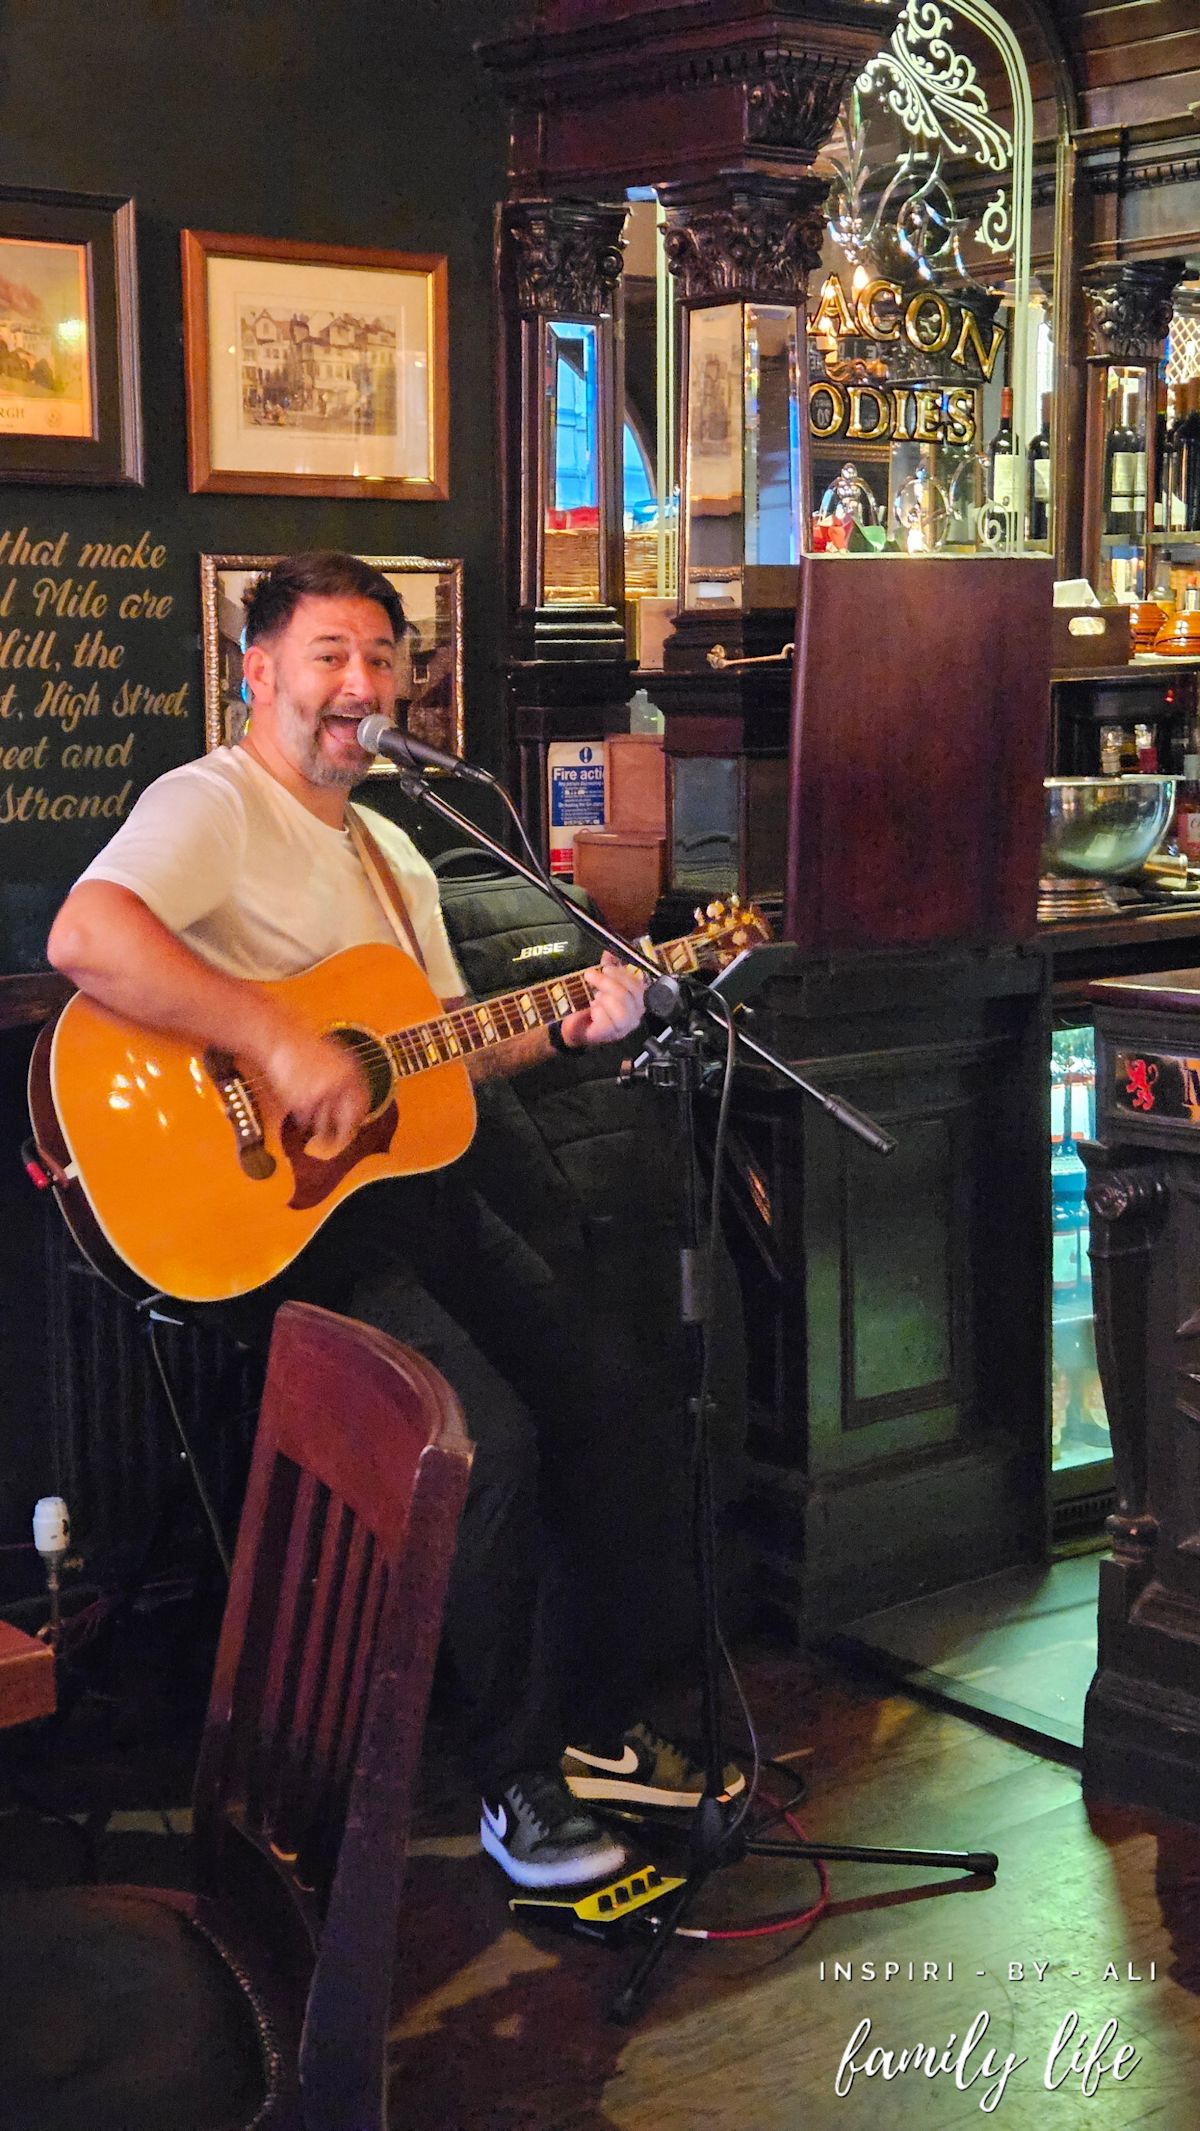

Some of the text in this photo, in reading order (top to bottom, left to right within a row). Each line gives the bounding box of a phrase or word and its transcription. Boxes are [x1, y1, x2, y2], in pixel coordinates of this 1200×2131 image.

[807, 274, 1006, 383] ACON
[809, 381, 976, 445] ODIES
[0, 527, 167, 569] that make
[33, 577, 108, 619] Mile
[119, 588, 174, 620] are
[73, 630, 125, 669] the
[34, 680, 99, 733] High
[61, 732, 135, 768] and
[553, 766, 604, 781] Fire acti
[0, 779, 134, 824] Strand
[511, 941, 569, 962] BOSE
